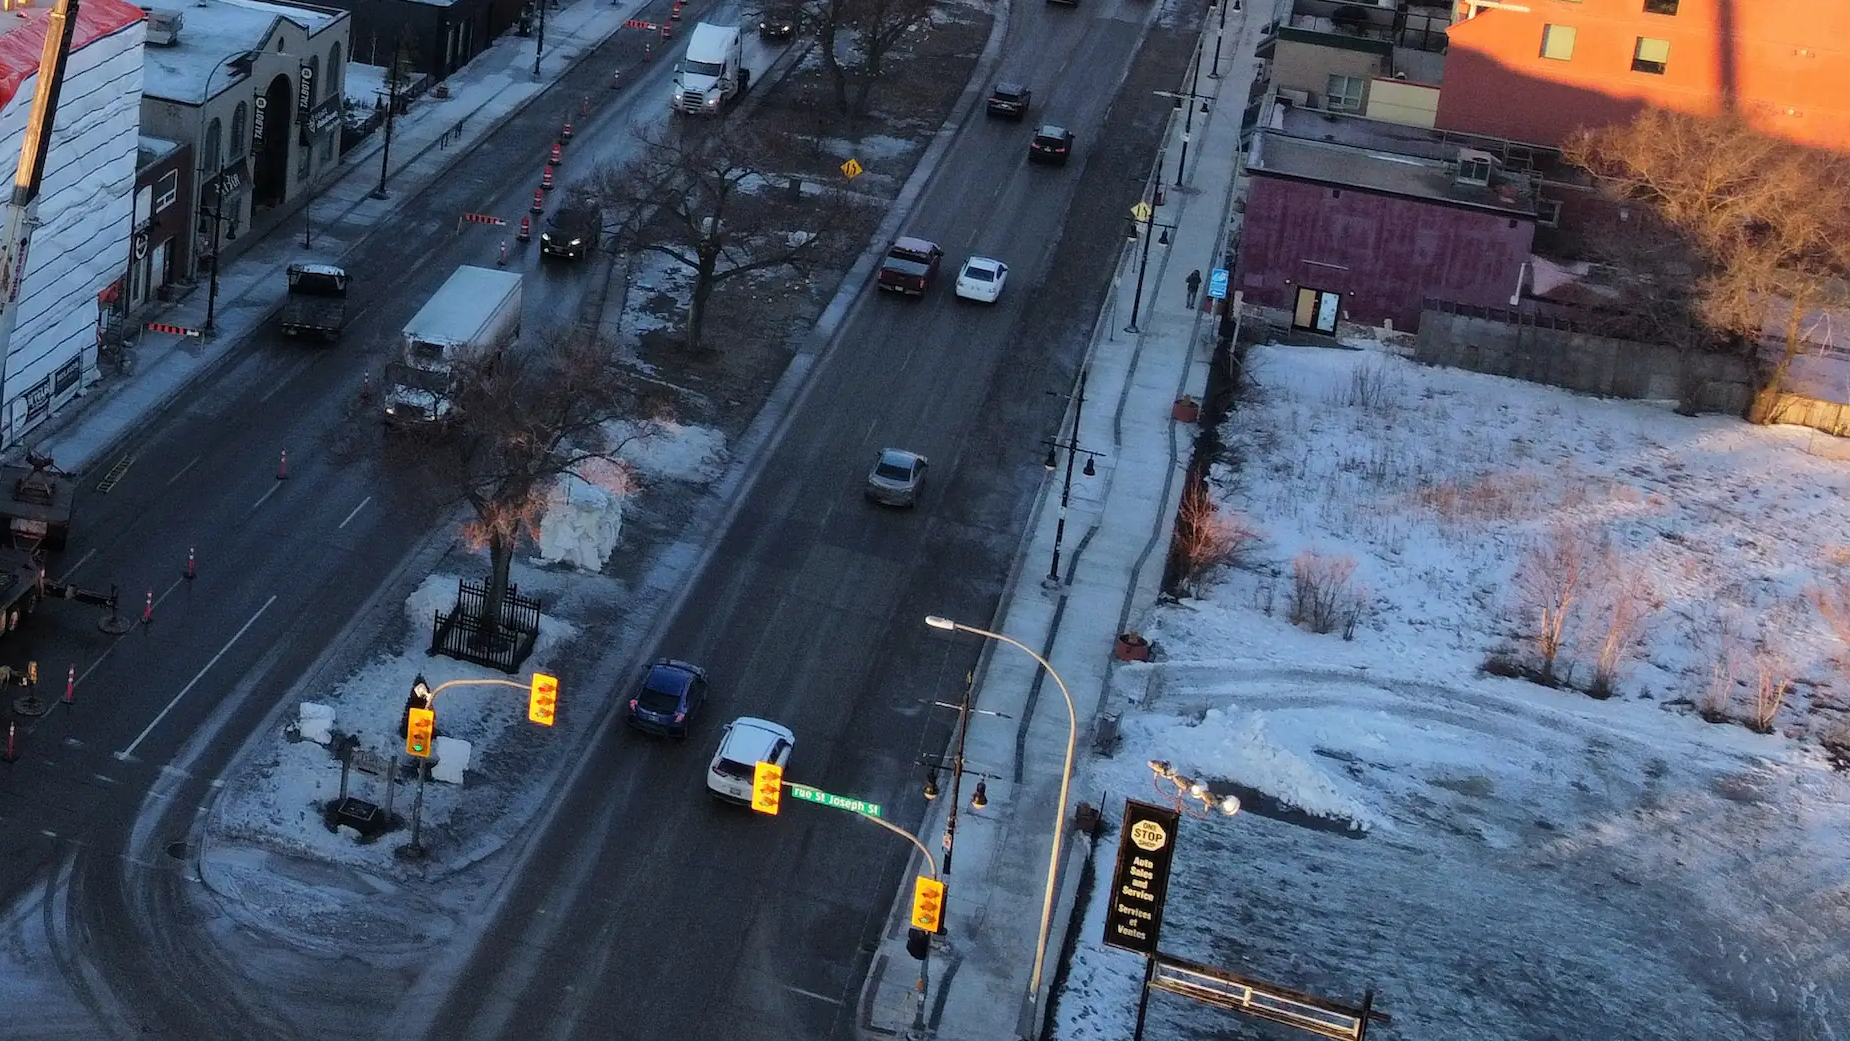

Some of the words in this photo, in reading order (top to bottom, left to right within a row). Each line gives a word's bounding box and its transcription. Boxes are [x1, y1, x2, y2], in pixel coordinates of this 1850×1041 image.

[299, 78, 311, 109] TALBOT
[253, 109, 265, 140] TALBOT
[794, 787, 812, 799] rue
[815, 791, 826, 802] St
[829, 795, 865, 812] Joseph
[867, 803, 879, 816] St
[1133, 827, 1163, 842] STOP
[1133, 856, 1154, 869] Auto
[1129, 866, 1154, 880] Sales
[1131, 878, 1148, 890] and
[1122, 885, 1154, 902] Service
[1117, 903, 1152, 921] Services
[1128, 918, 1138, 928] et
[1117, 924, 1147, 941] Ventes
